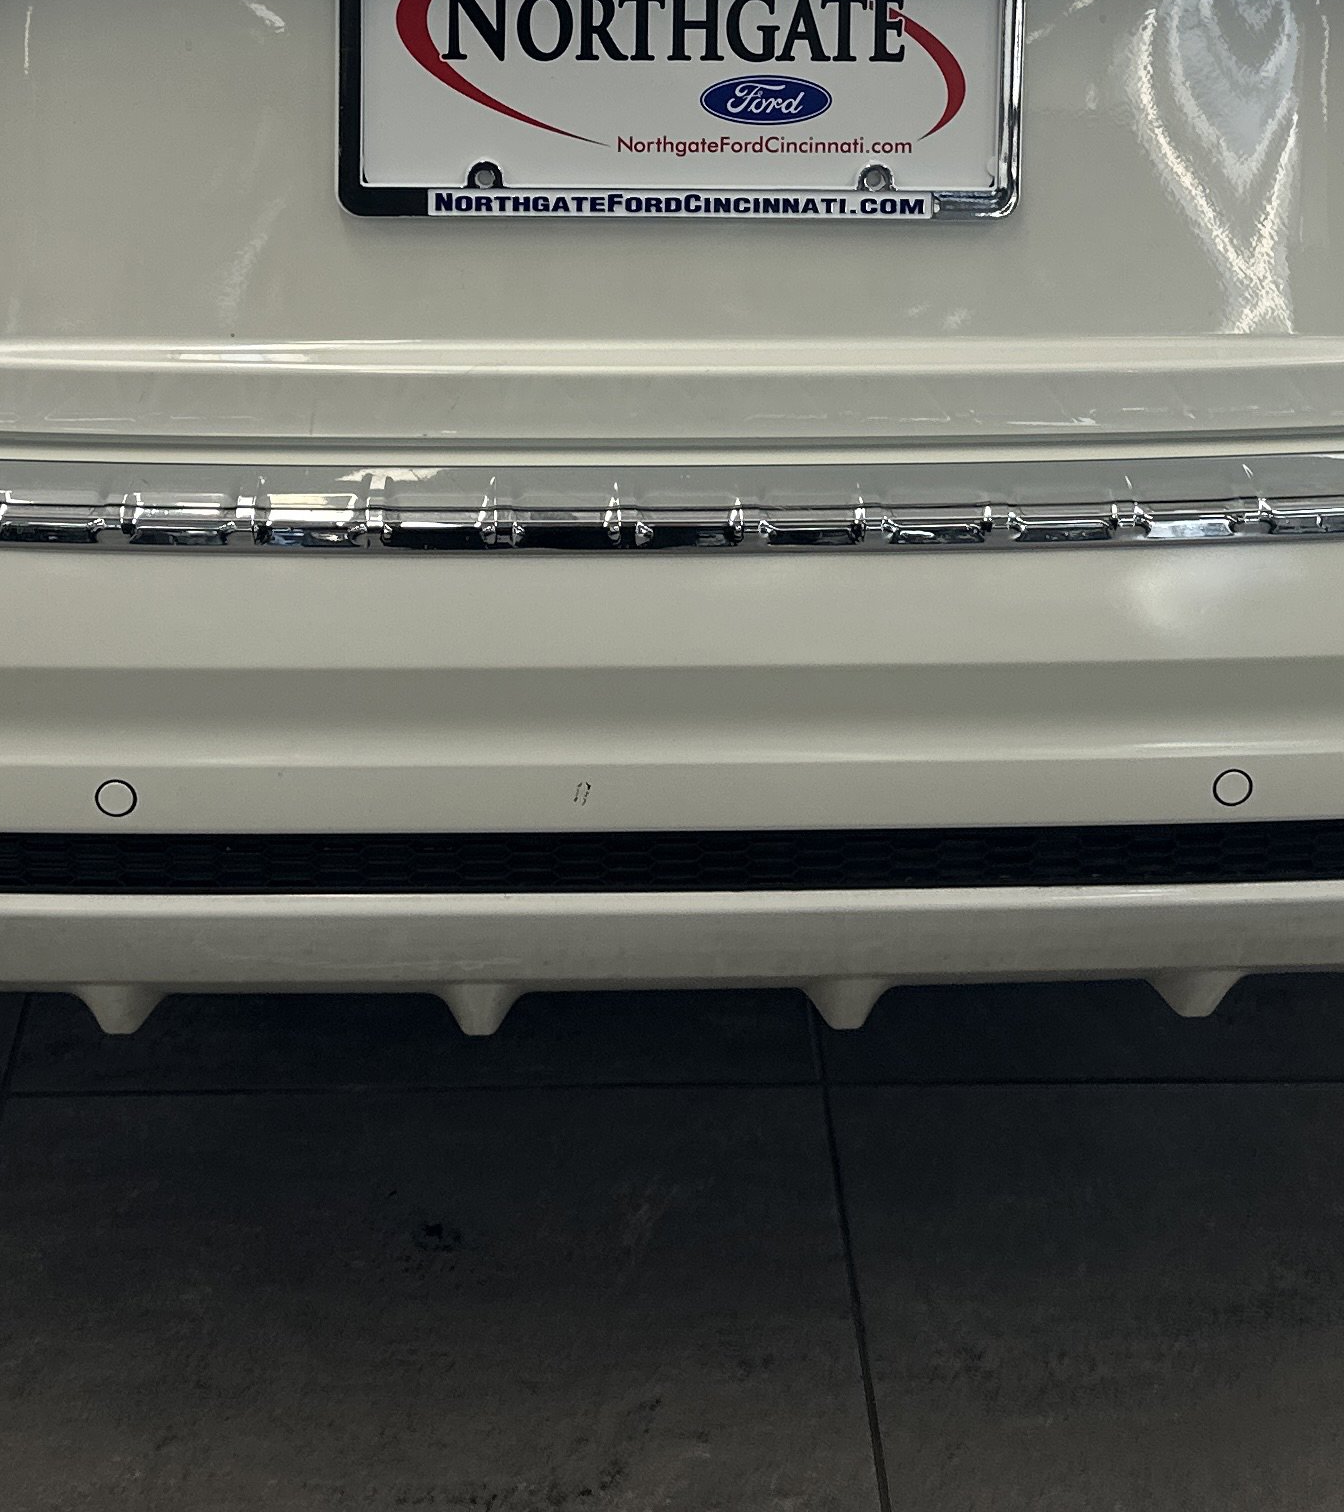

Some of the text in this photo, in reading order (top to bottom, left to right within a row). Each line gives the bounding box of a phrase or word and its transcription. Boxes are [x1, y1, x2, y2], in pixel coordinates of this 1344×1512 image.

[726, 82, 805, 114] Ford
[616, 135, 913, 157] NorthgateFordCincinnati.com
[433, 192, 925, 216] NORTHGATEFORDCINCINNATI.COM
